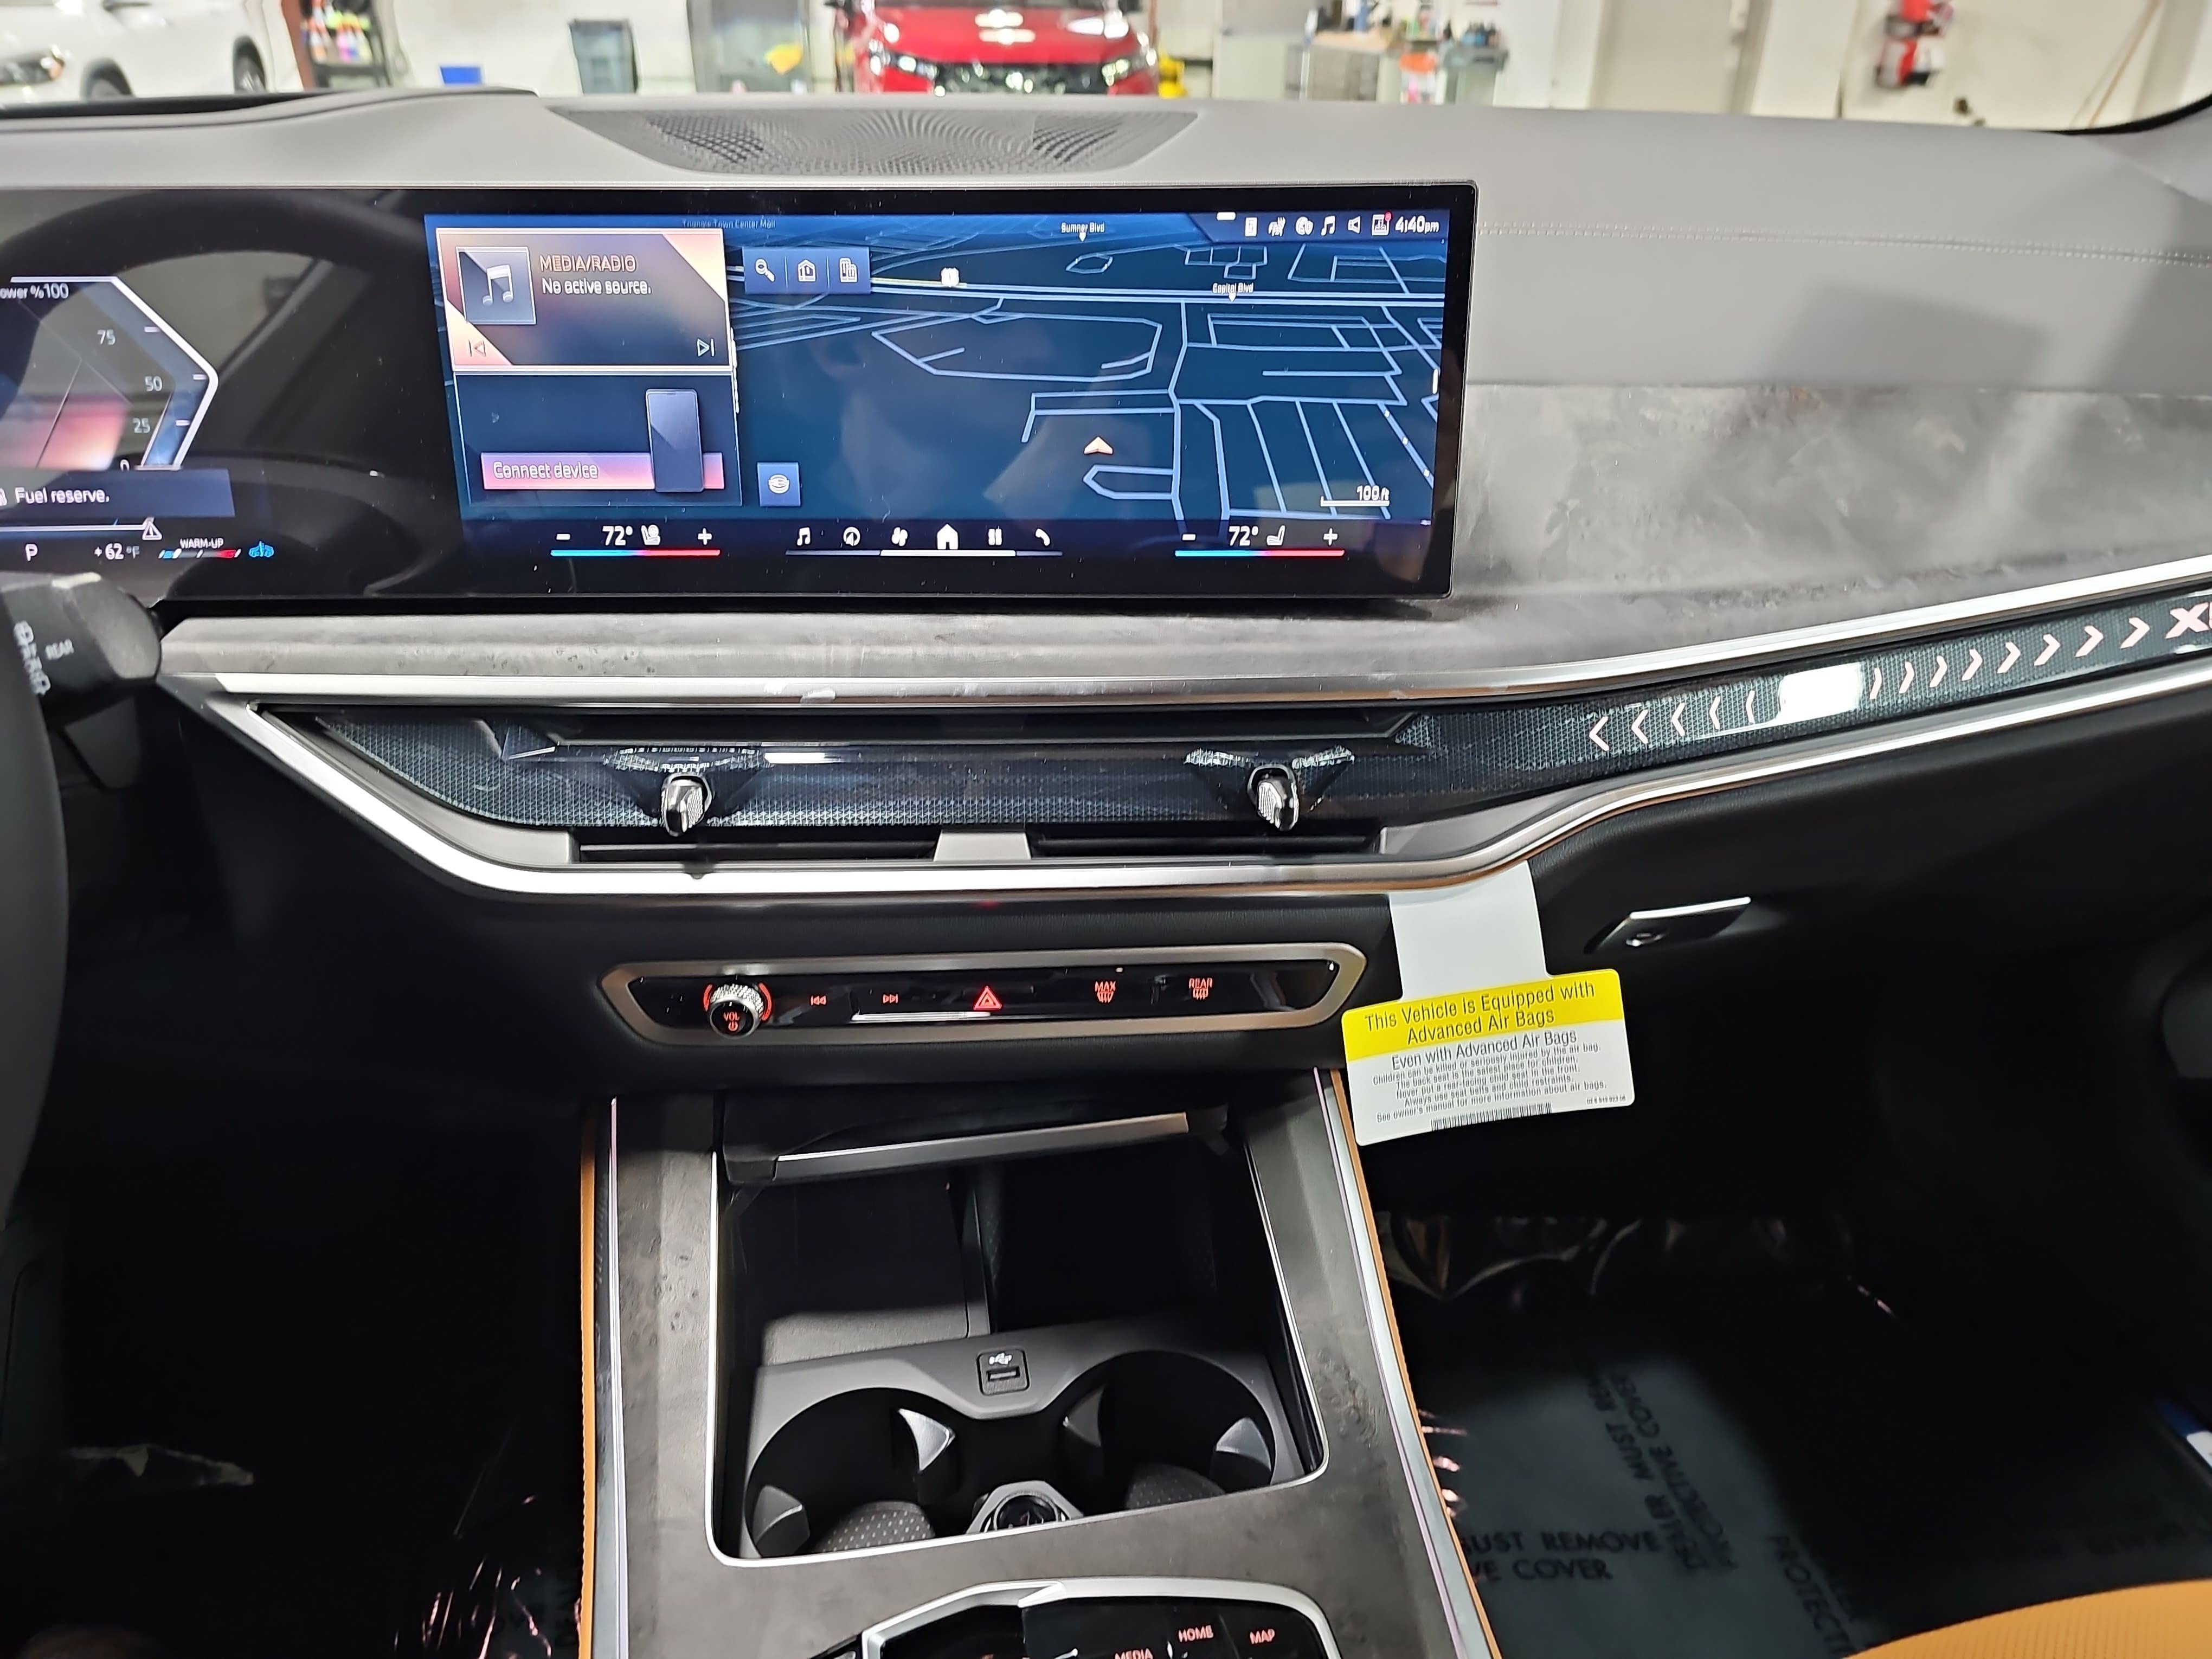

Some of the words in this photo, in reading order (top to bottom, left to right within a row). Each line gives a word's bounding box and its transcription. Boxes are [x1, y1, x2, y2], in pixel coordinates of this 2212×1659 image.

[735, 218, 758, 228] Center
[1089, 222, 1105, 233] Blvd
[539, 255, 636, 272] MEDIA/RADIO
[0, 287, 28, 299] ower
[542, 277, 561, 294] No
[564, 277, 602, 294] active
[605, 280, 651, 294] source.
[1238, 282, 1254, 293] Blvd
[97, 329, 116, 345] 75
[144, 376, 163, 391] 50
[132, 417, 151, 433] 25
[493, 461, 550, 479] Connect
[554, 461, 599, 479] device
[15, 487, 48, 504] Fuel
[51, 489, 110, 504] reserve.
[179, 537, 224, 549] WARM-UP
[25, 544, 38, 561] P
[2165, 602, 2212, 639] X
[1095, 980, 1116, 992] MAX
[1188, 978, 1213, 989] REAR
[1364, 1011, 1397, 1032] This
[1401, 1001, 1457, 1024] Vehicle
[1462, 997, 1475, 1014] is
[1481, 984, 1554, 1012] Equipped
[1560, 980, 1594, 1000] with
[723, 1012, 740, 1021] VOL
[1407, 1016, 1482, 1045] Advanced
[1488, 1012, 1509, 1032] Air
[1516, 1009, 1554, 1028] Bags
[1392, 1053, 1422, 1070] Even
[1425, 1046, 1452, 1064] with
[1456, 1035, 1517, 1059] Advanced
[1522, 1033, 1540, 1049] Air
[1544, 1031, 1577, 1046] Bags
[1373, 1072, 1405, 1085] Children
[1407, 1069, 1421, 1079] can
[1424, 1066, 1433, 1075] be
[1436, 1062, 1457, 1073] killed
[1459, 1062, 1467, 1070] or
[1470, 1053, 1507, 1068] seriously
[1510, 1048, 1538, 1061] injured
[1541, 1047, 1550, 1057] by
[1553, 1046, 1566, 1055] the
[1569, 1045, 1579, 1053] air
[1583, 1042, 1600, 1052] bag.
[1396, 1079, 1410, 1090] The
[1413, 1075, 1431, 1086] back
[1433, 1073, 1449, 1083] seat
[1461, 1068, 1474, 1079] the
[1477, 1065, 1501, 1076] safest
[1503, 1061, 1525, 1073] place
[1527, 1059, 1539, 1068] for
[1541, 1055, 1578, 1066] children.
[1396, 1089, 1418, 1099] Never
[1421, 1085, 1434, 1096] put
[1444, 1077, 1487, 1091] rear-facing
[1490, 1071, 1509, 1083] child
[1512, 1070, 1528, 1081] seat
[1531, 1069, 1539, 1077] in
[1541, 1065, 1554, 1076] the
[1557, 1064, 1580, 1074] front.
[1405, 1096, 1431, 1108] Always
[1435, 1092, 1448, 1102] use
[1451, 1089, 1467, 1099] seat
[1470, 1084, 1489, 1096] belts
[1492, 1083, 1506, 1094] and
[1509, 1079, 1528, 1090] child
[1532, 1075, 1573, 1086] restraints.
[1377, 1111, 1391, 1123] See
[1393, 1106, 1423, 1120] owner's
[1426, 1099, 1454, 1115] manual
[1457, 1096, 1468, 1106] for
[1471, 1096, 1491, 1105] more
[1494, 1086, 1541, 1102] information
[1544, 1084, 1567, 1095] about
[1570, 1083, 1581, 1092] air
[1584, 1081, 1607, 1091] bags.
[1542, 1529, 1661, 1554] REMOVE
[1512, 1558, 1613, 1581] COVER
[1178, 1625, 1214, 1643] HOME
[1249, 1629, 1275, 1644] MAP
